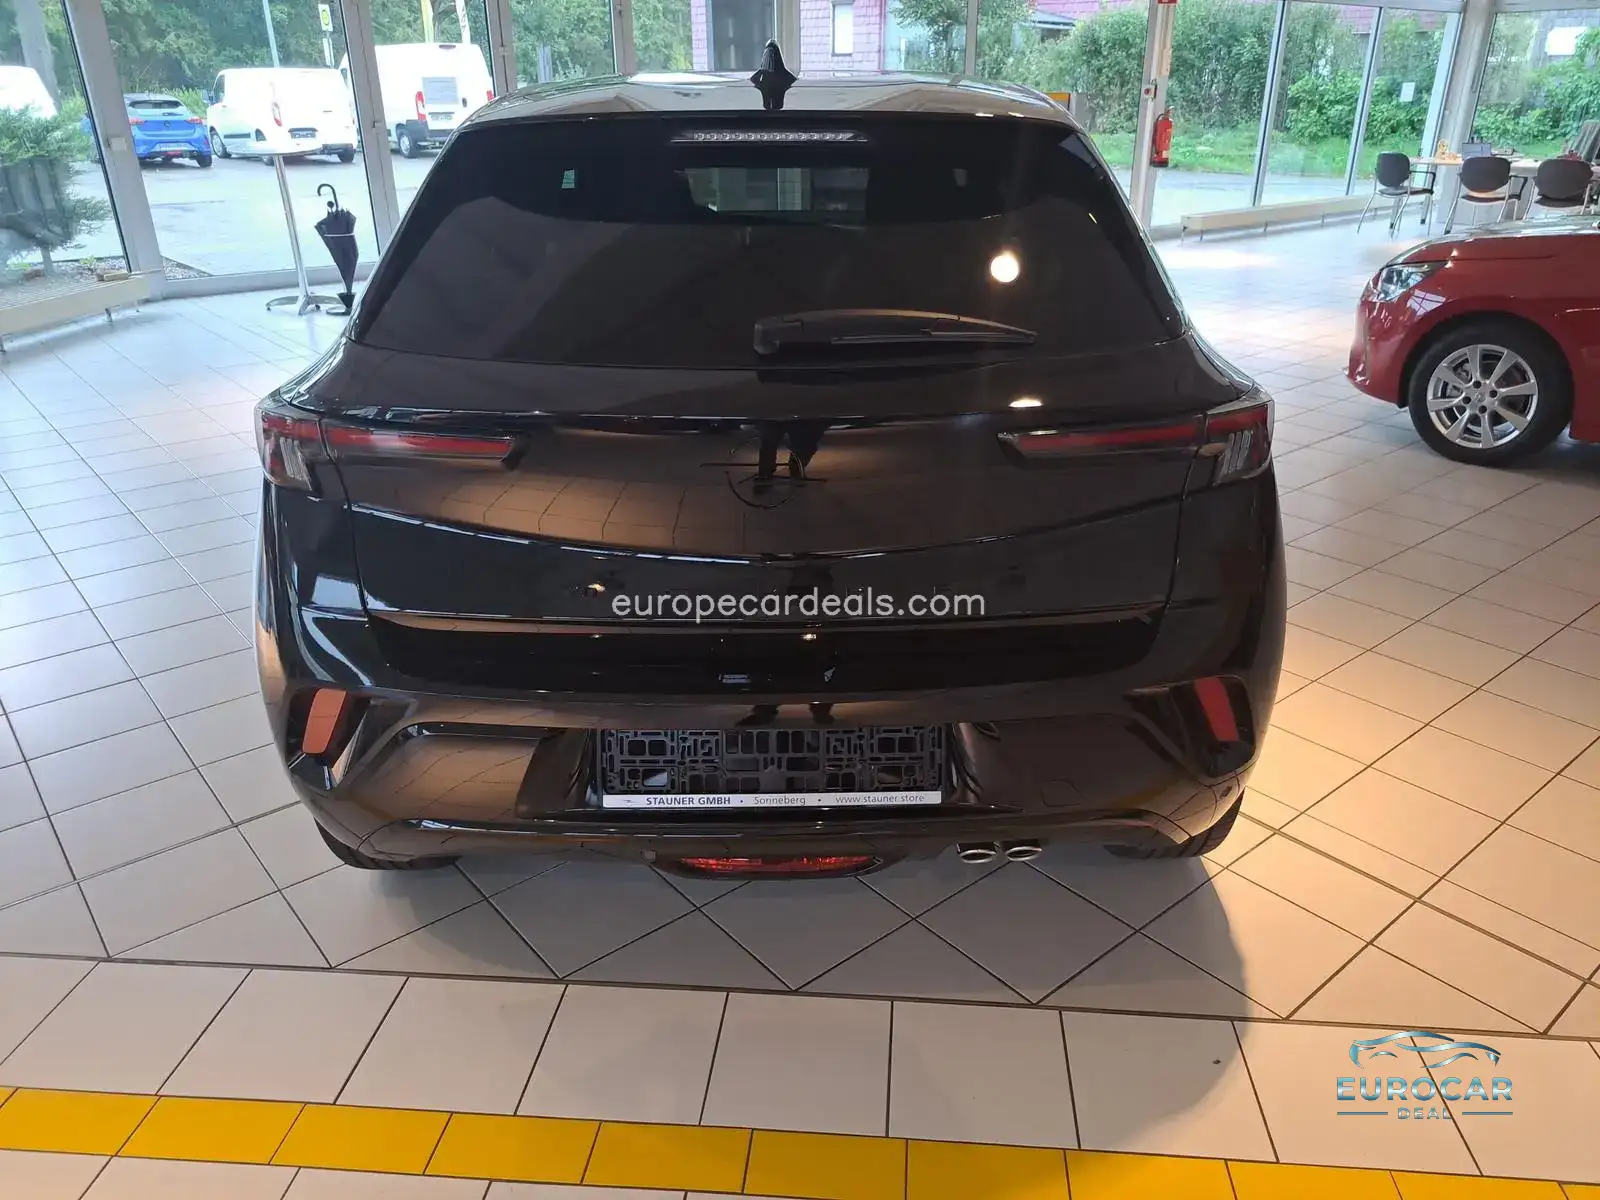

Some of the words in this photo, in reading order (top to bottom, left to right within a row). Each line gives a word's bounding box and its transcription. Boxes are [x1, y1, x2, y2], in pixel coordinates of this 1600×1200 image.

[646, 796, 694, 806] STAUNER
[698, 796, 731, 805] GMBH
[754, 796, 806, 806] Sonneberg
[835, 793, 925, 804] www.staunerstore
